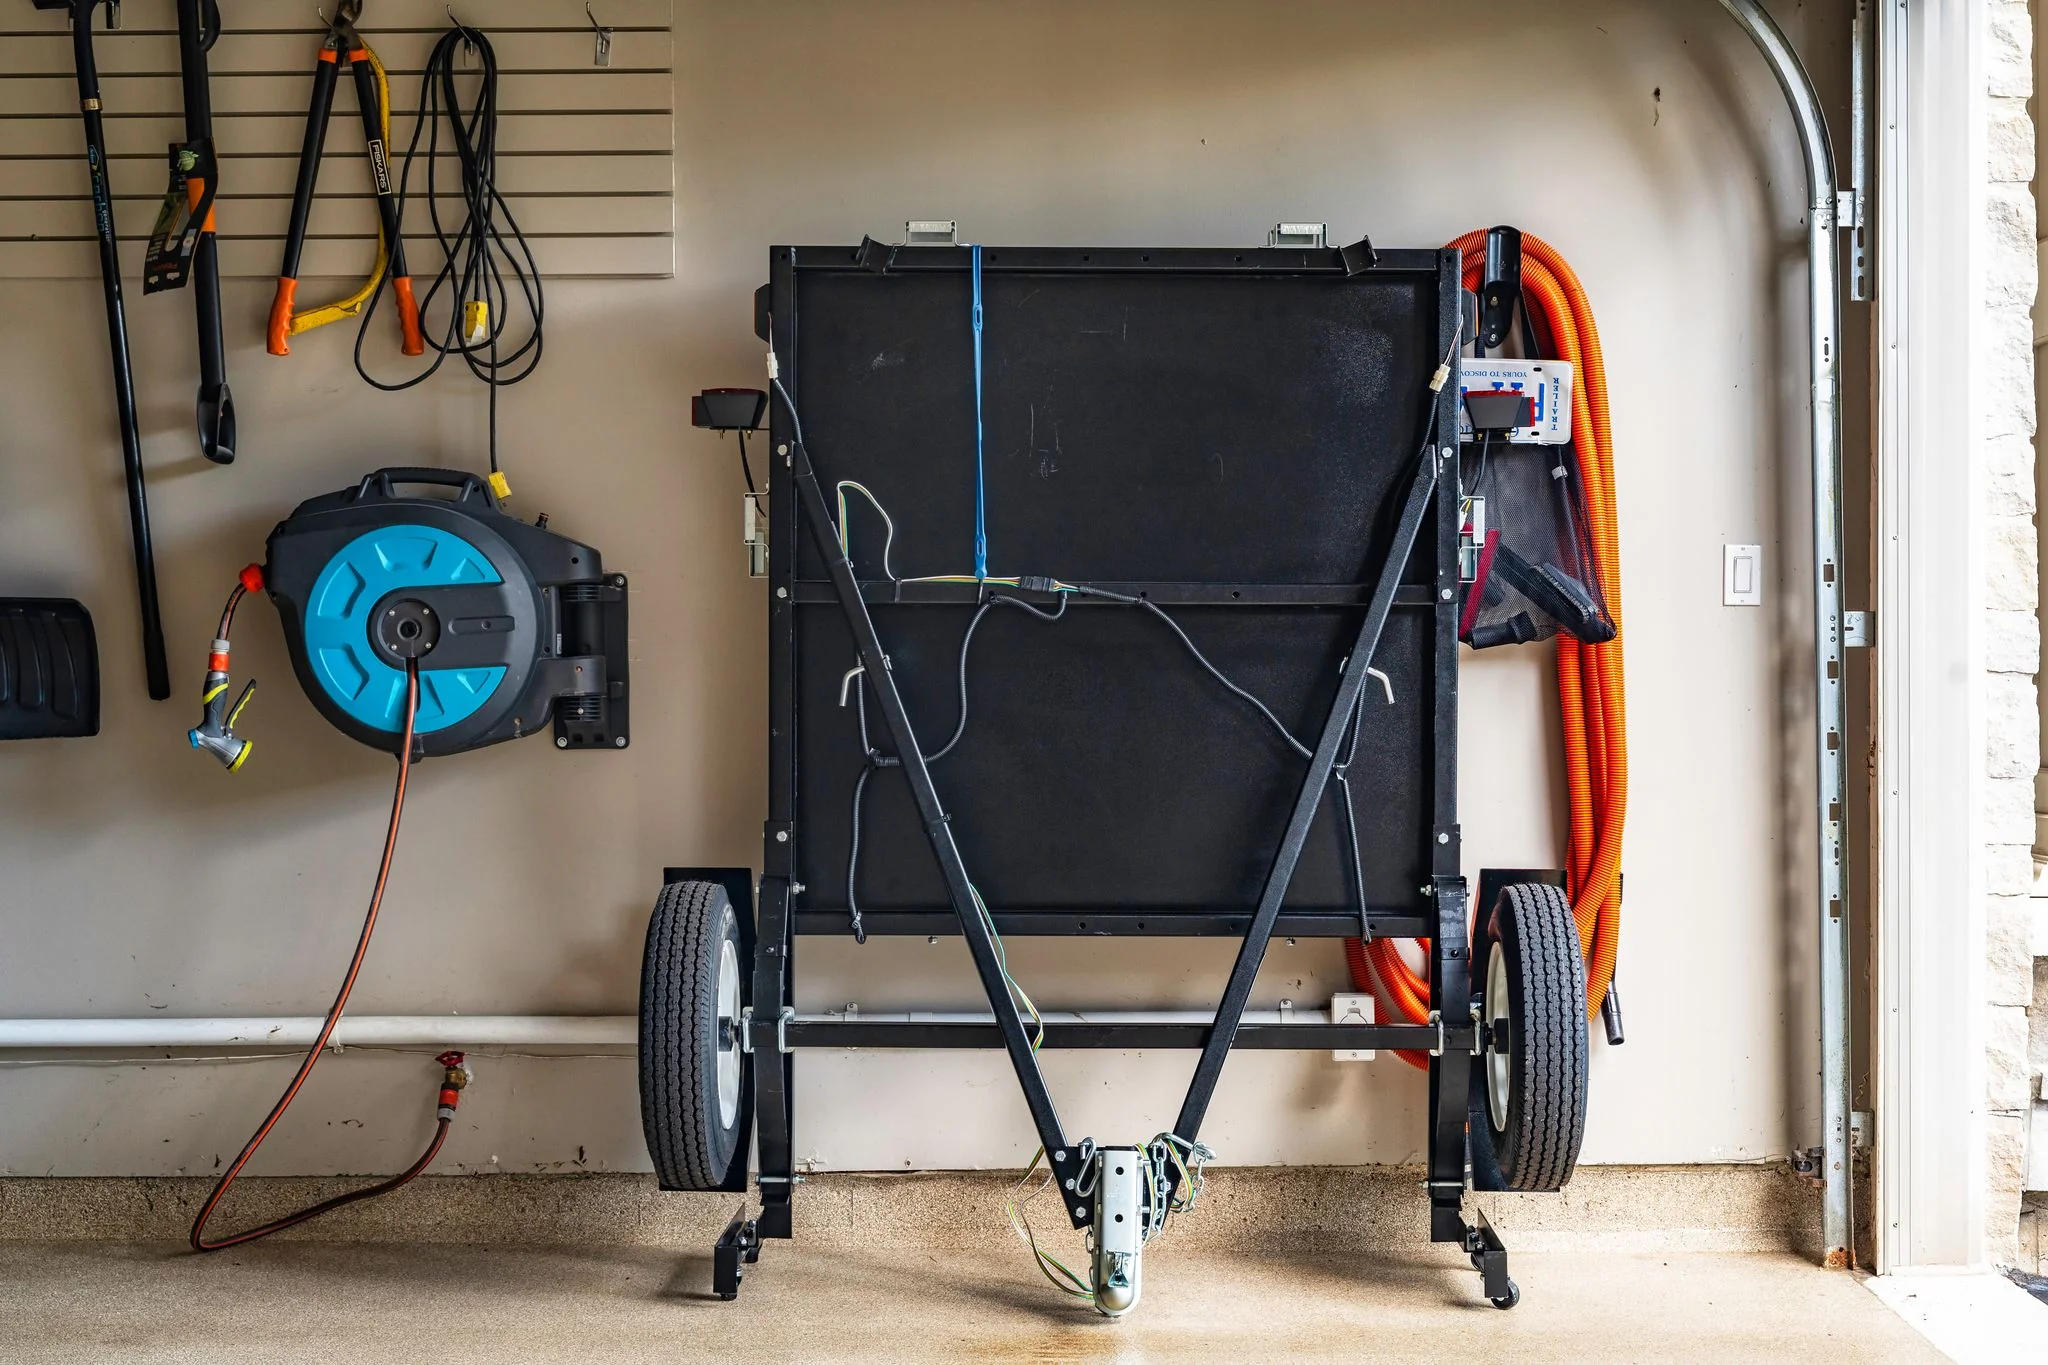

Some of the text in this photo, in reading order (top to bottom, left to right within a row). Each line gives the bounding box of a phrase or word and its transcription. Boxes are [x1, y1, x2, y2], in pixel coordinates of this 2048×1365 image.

[372, 144, 387, 189] FISKARS
[1490, 370, 1500, 378] TO
[1551, 377, 1559, 430] TRAILER
